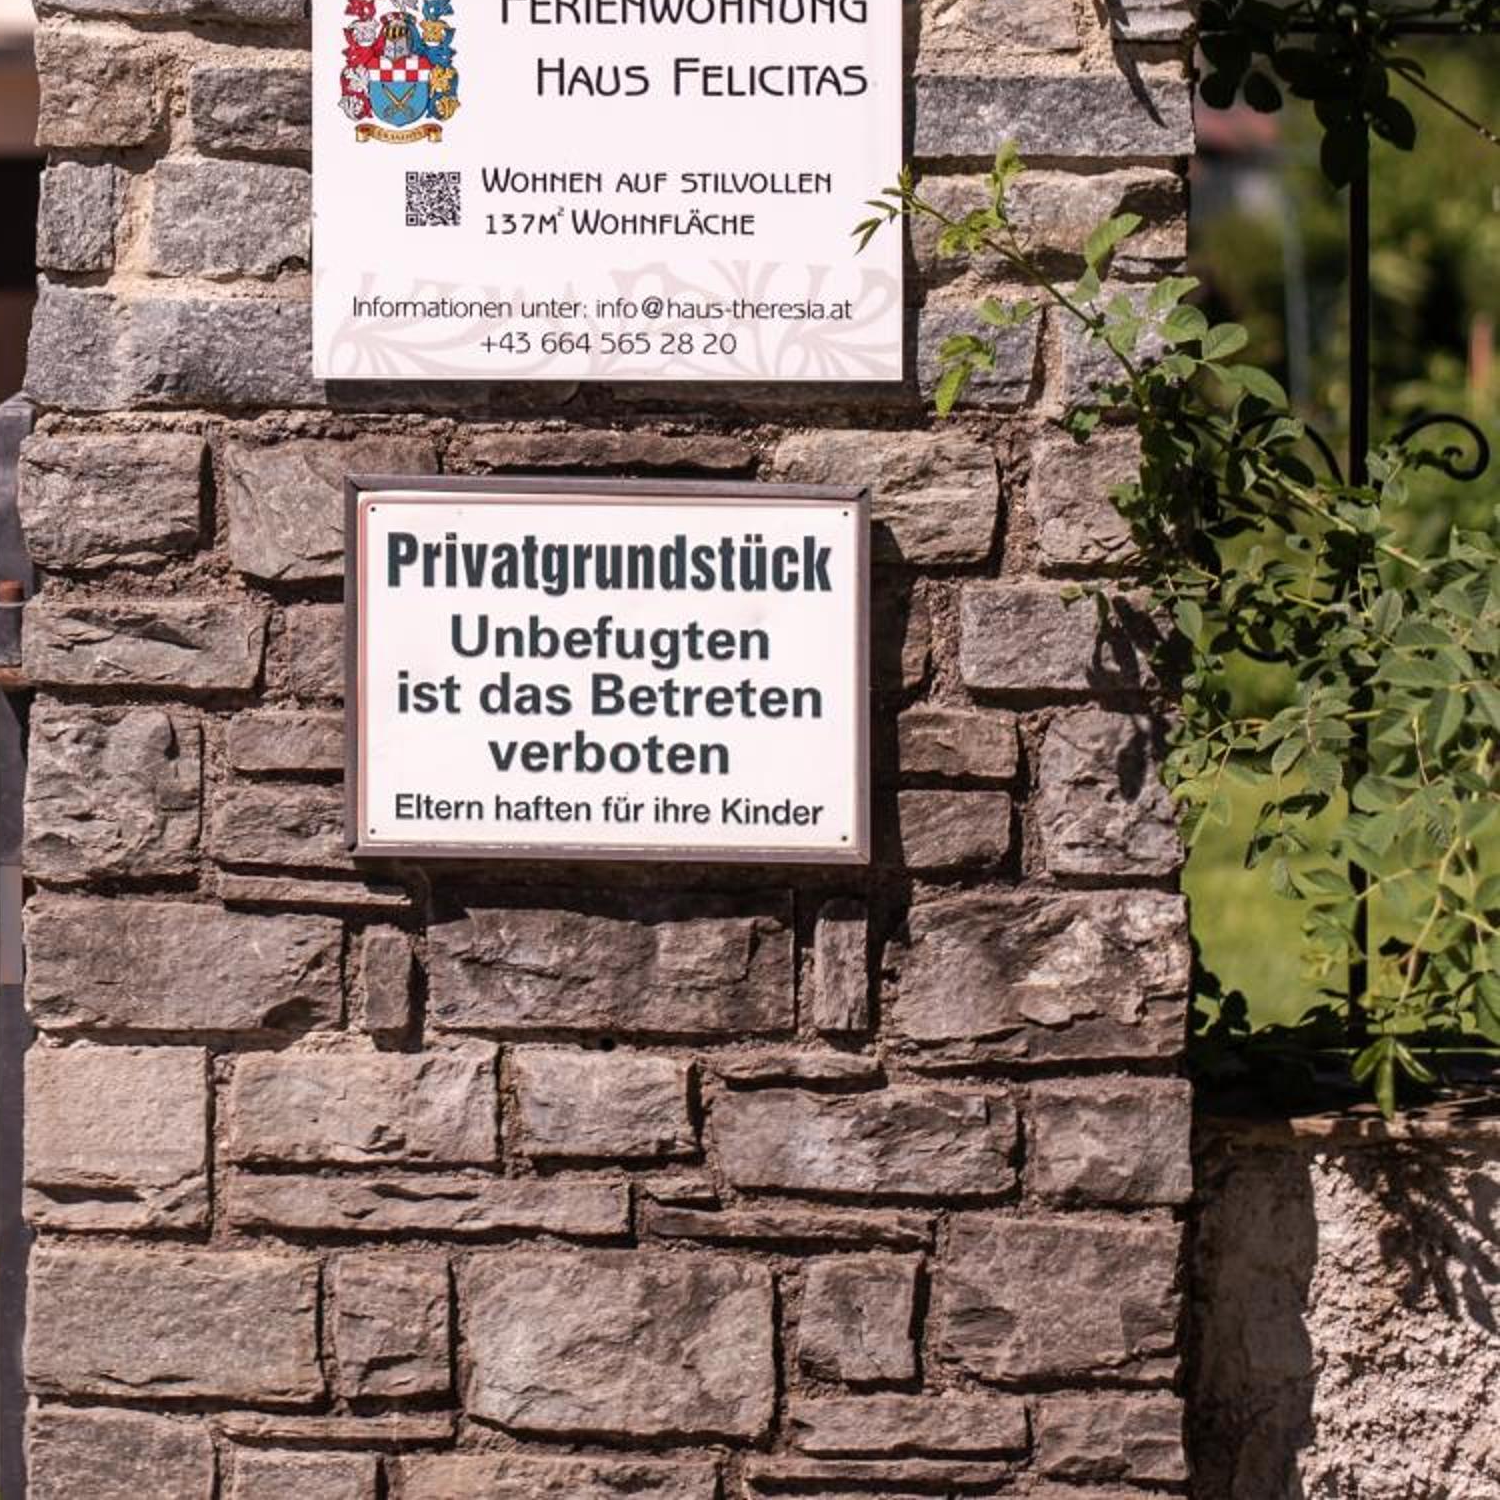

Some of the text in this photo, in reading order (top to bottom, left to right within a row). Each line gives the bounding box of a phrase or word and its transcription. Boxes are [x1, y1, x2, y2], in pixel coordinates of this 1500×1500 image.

[353, 295, 853, 320] Informationen unter: info@haus-theresia.at
[481, 331, 737, 355] +43 664 565 28 20
[387, 531, 832, 596] Privatgrundstück
[451, 614, 769, 668] Unbefugten
[398, 670, 822, 719] ist das Betreten
[488, 729, 729, 775] verboten
[395, 793, 824, 826] Eltern haften für ihre Kinder
